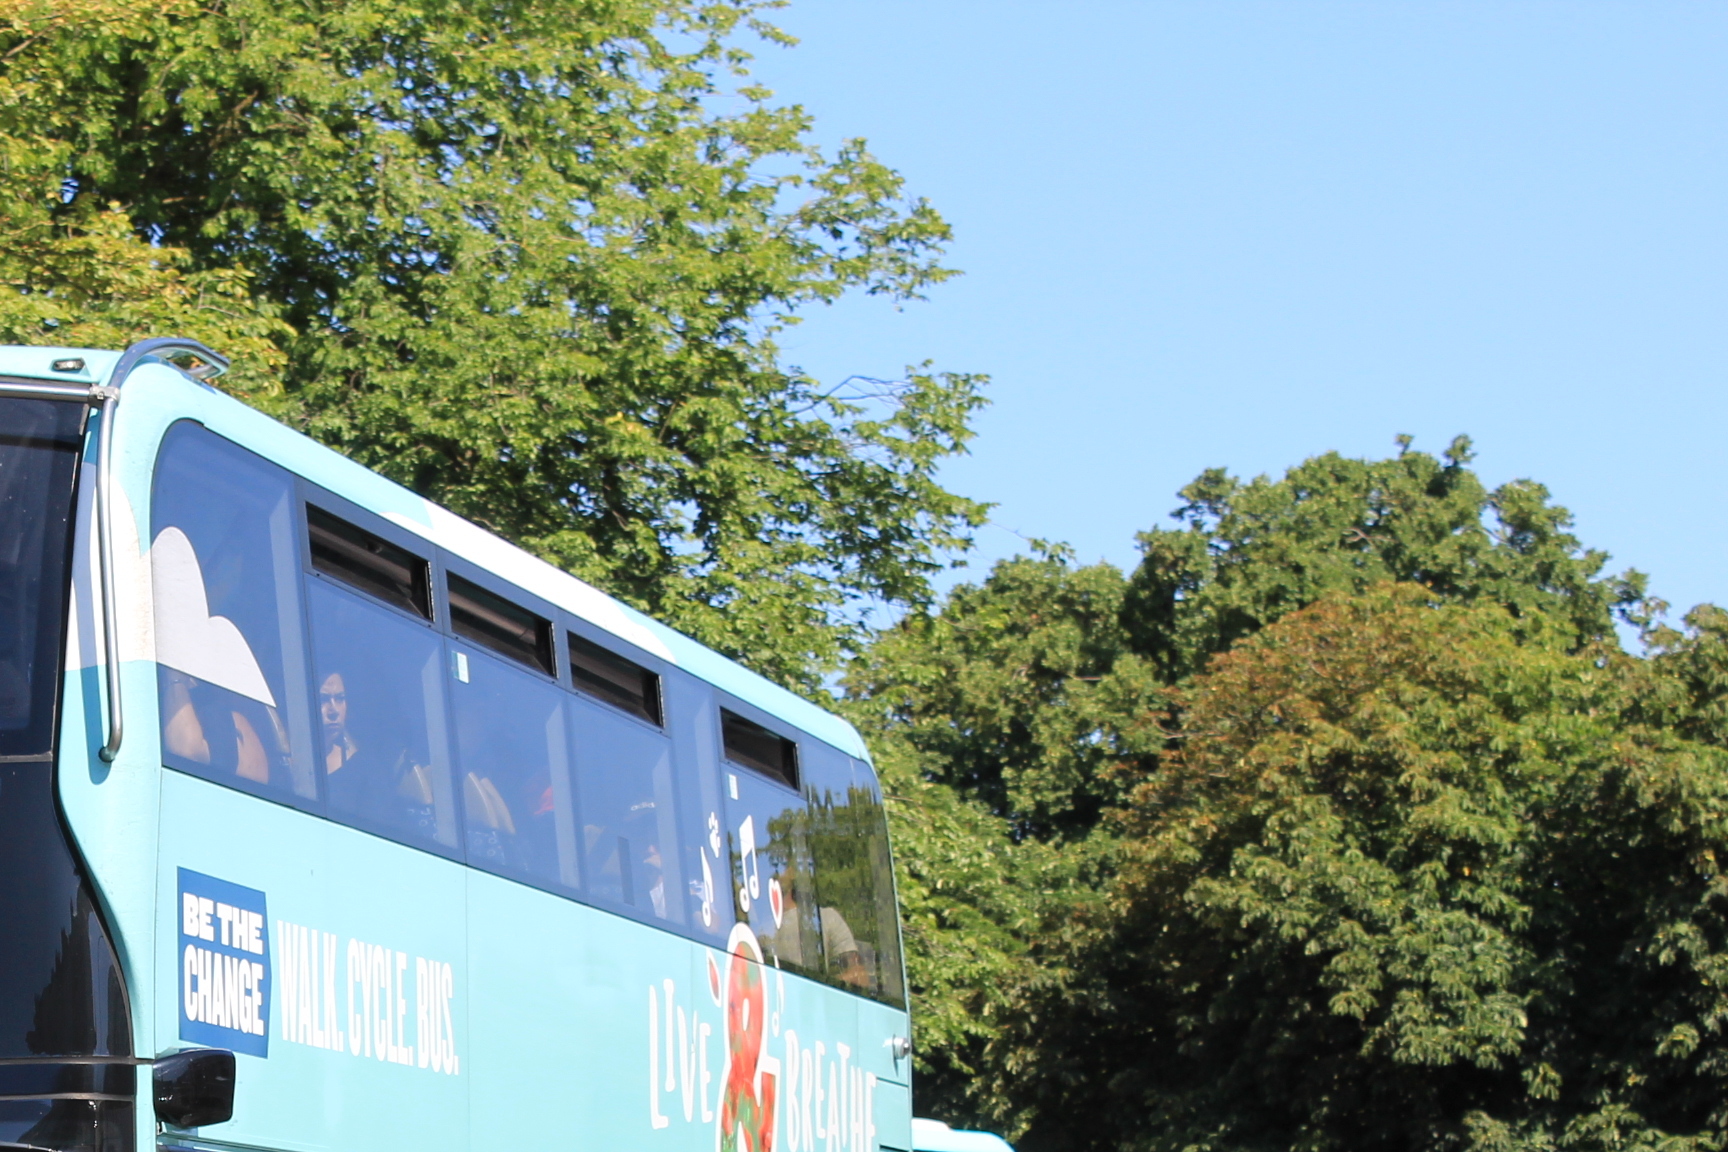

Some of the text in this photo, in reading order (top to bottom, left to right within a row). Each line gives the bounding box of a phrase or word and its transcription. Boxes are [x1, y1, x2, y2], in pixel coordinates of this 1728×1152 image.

[182, 891, 264, 956] BE THE
[183, 943, 265, 1037] CHANGE
[276, 918, 460, 1076] WALK. CYCLE. BUS.
[648, 977, 714, 1130] LIVE
